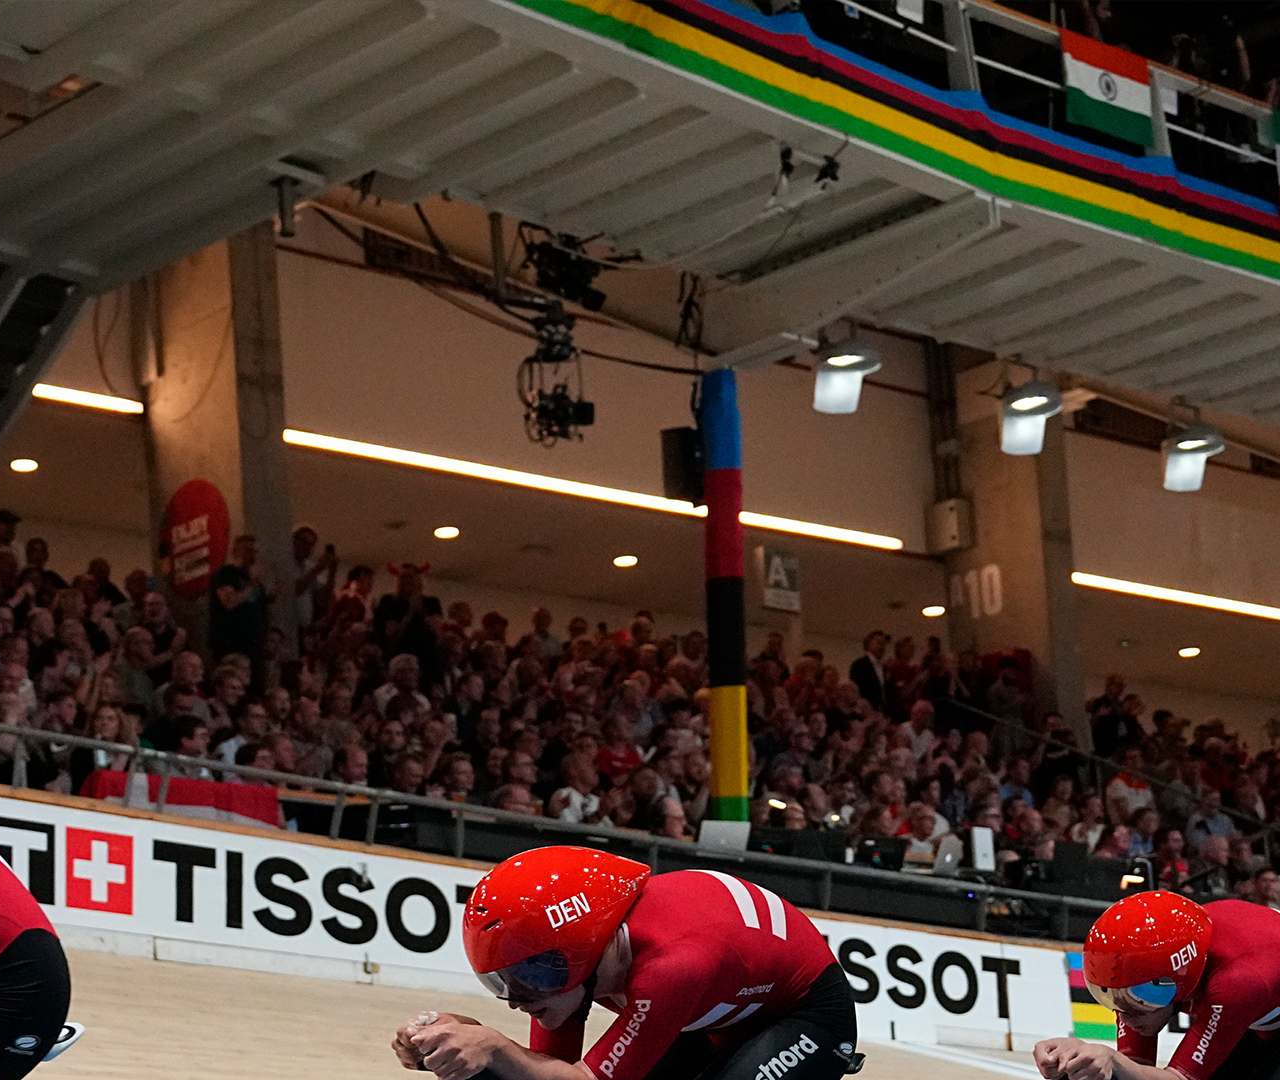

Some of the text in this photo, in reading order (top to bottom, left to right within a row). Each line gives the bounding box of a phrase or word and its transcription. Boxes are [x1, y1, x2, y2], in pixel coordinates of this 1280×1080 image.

[152, 838, 473, 954] TISSO
[545, 892, 591, 929] DEN
[822, 934, 1022, 1019] SSOT
[1170, 941, 1198, 972] DEN
[599, 999, 652, 1079] postnord
[1191, 1005, 1223, 1065] postnord
